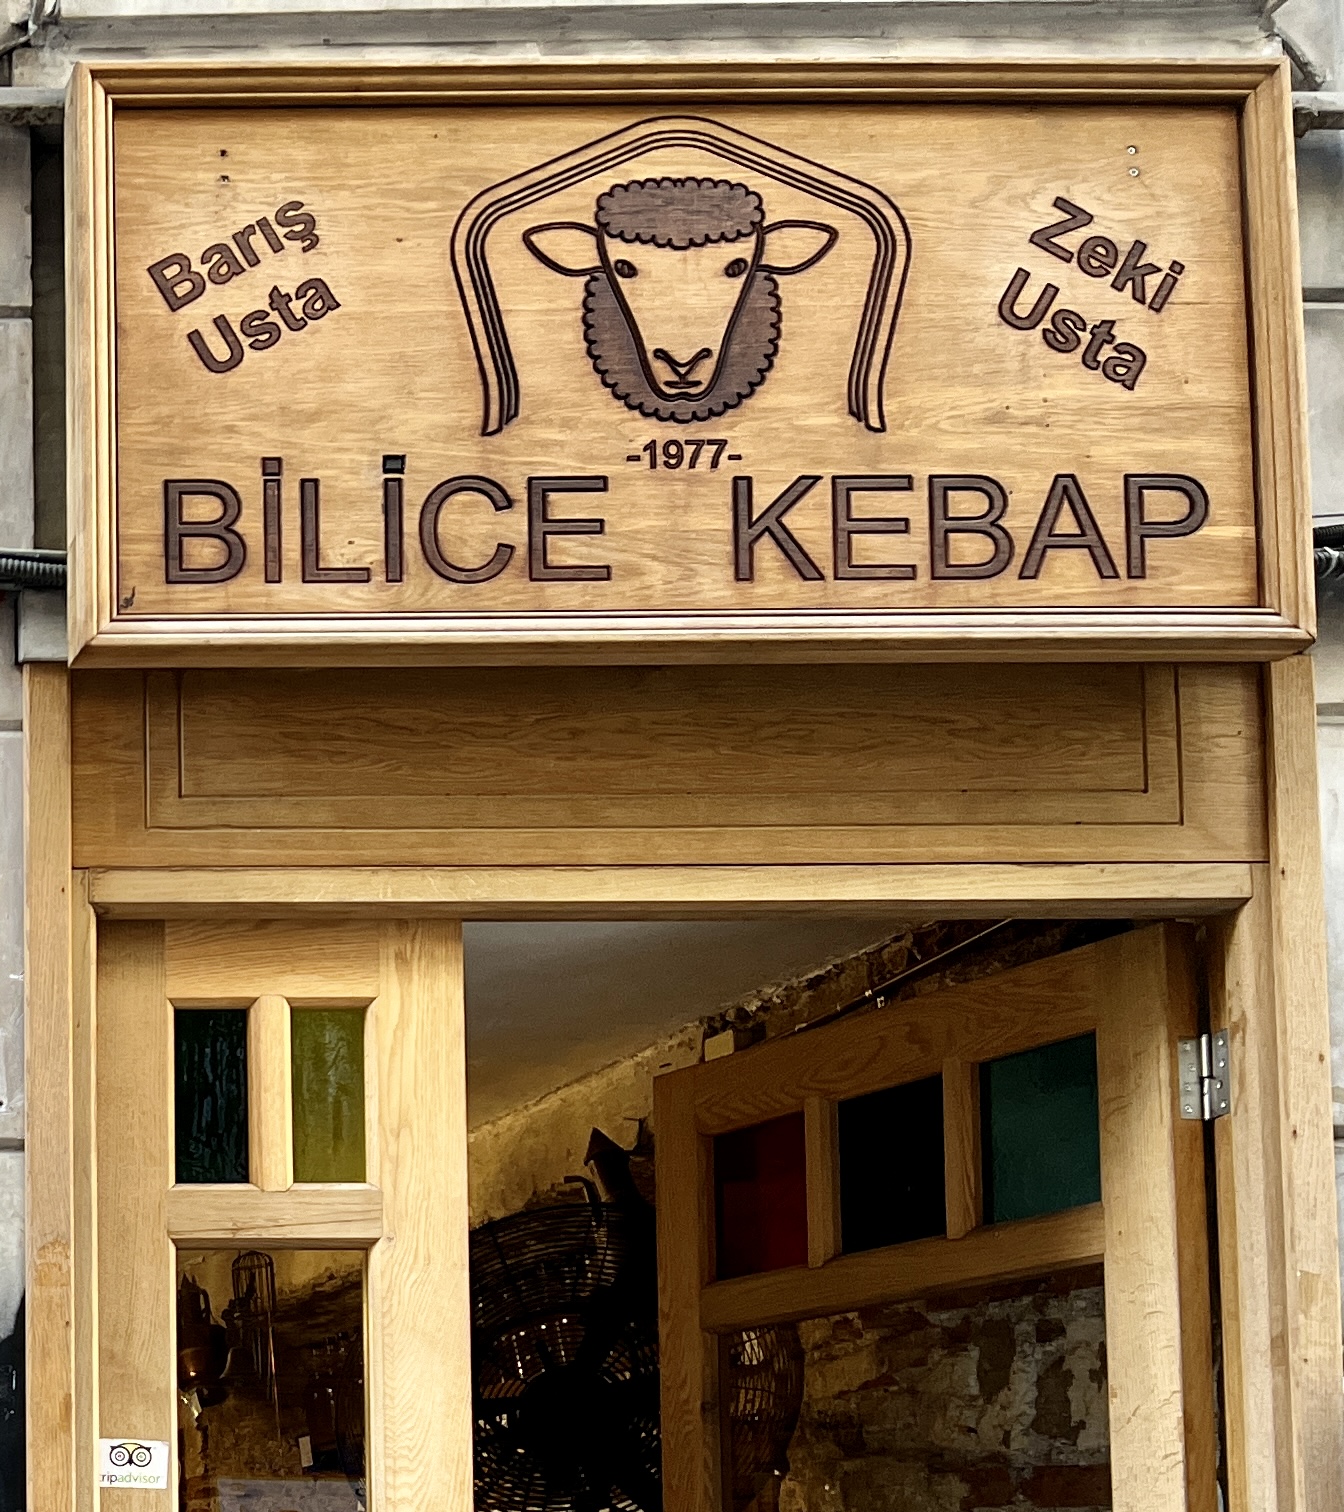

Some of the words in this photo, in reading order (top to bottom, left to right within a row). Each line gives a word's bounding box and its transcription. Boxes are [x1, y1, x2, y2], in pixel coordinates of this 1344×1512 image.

[146, 194, 323, 313] Barış
[1028, 195, 1188, 316] Zeki
[185, 268, 343, 378] Usta
[995, 266, 1151, 392] Usta
[161, 455, 612, 585] BİLİCE
[732, 472, 1211, 582] KEBAP
